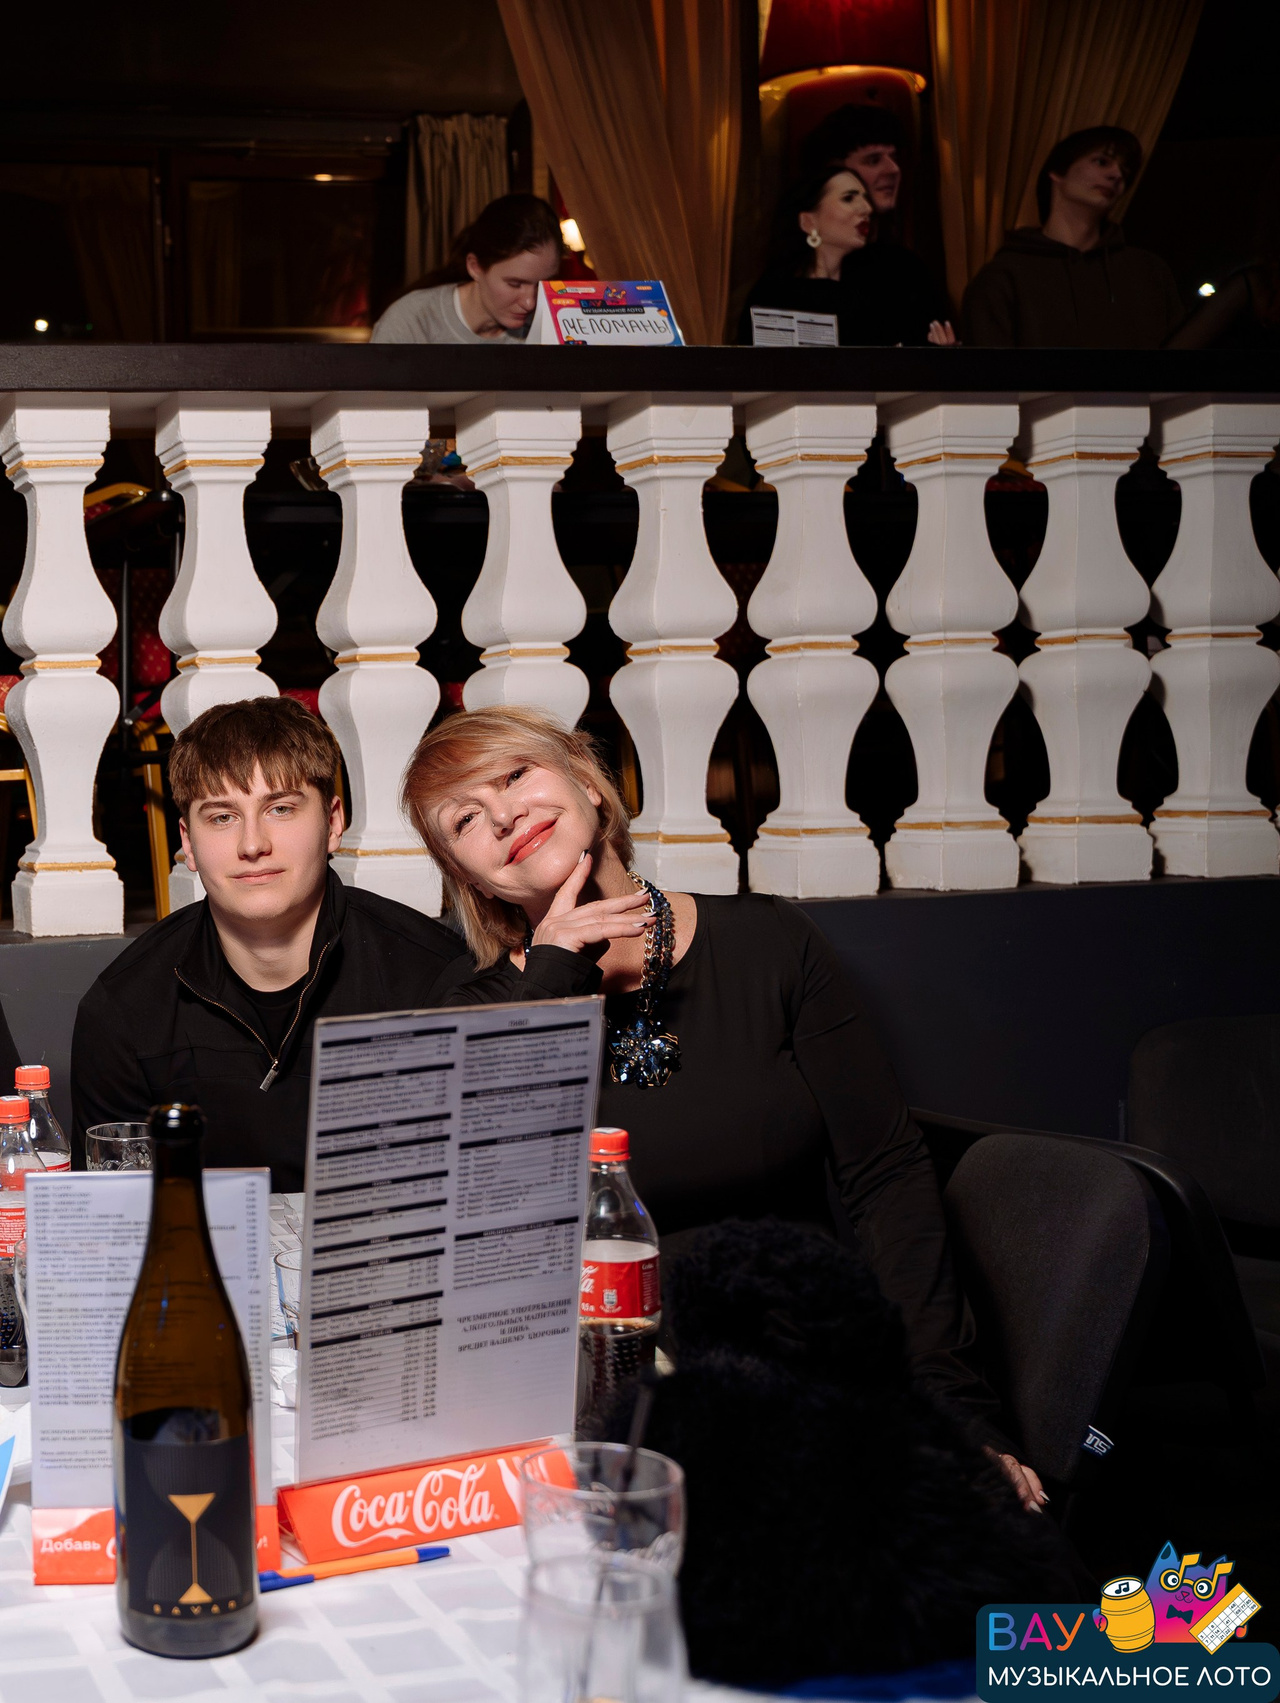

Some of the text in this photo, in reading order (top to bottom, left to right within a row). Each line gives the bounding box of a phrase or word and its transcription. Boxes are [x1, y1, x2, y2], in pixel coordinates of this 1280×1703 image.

[561, 318, 672, 336] МЕЛОМАНЫ
[331, 1462, 496, 1548] Coca-Cola
[40, 1538, 101, 1554] Добавь
